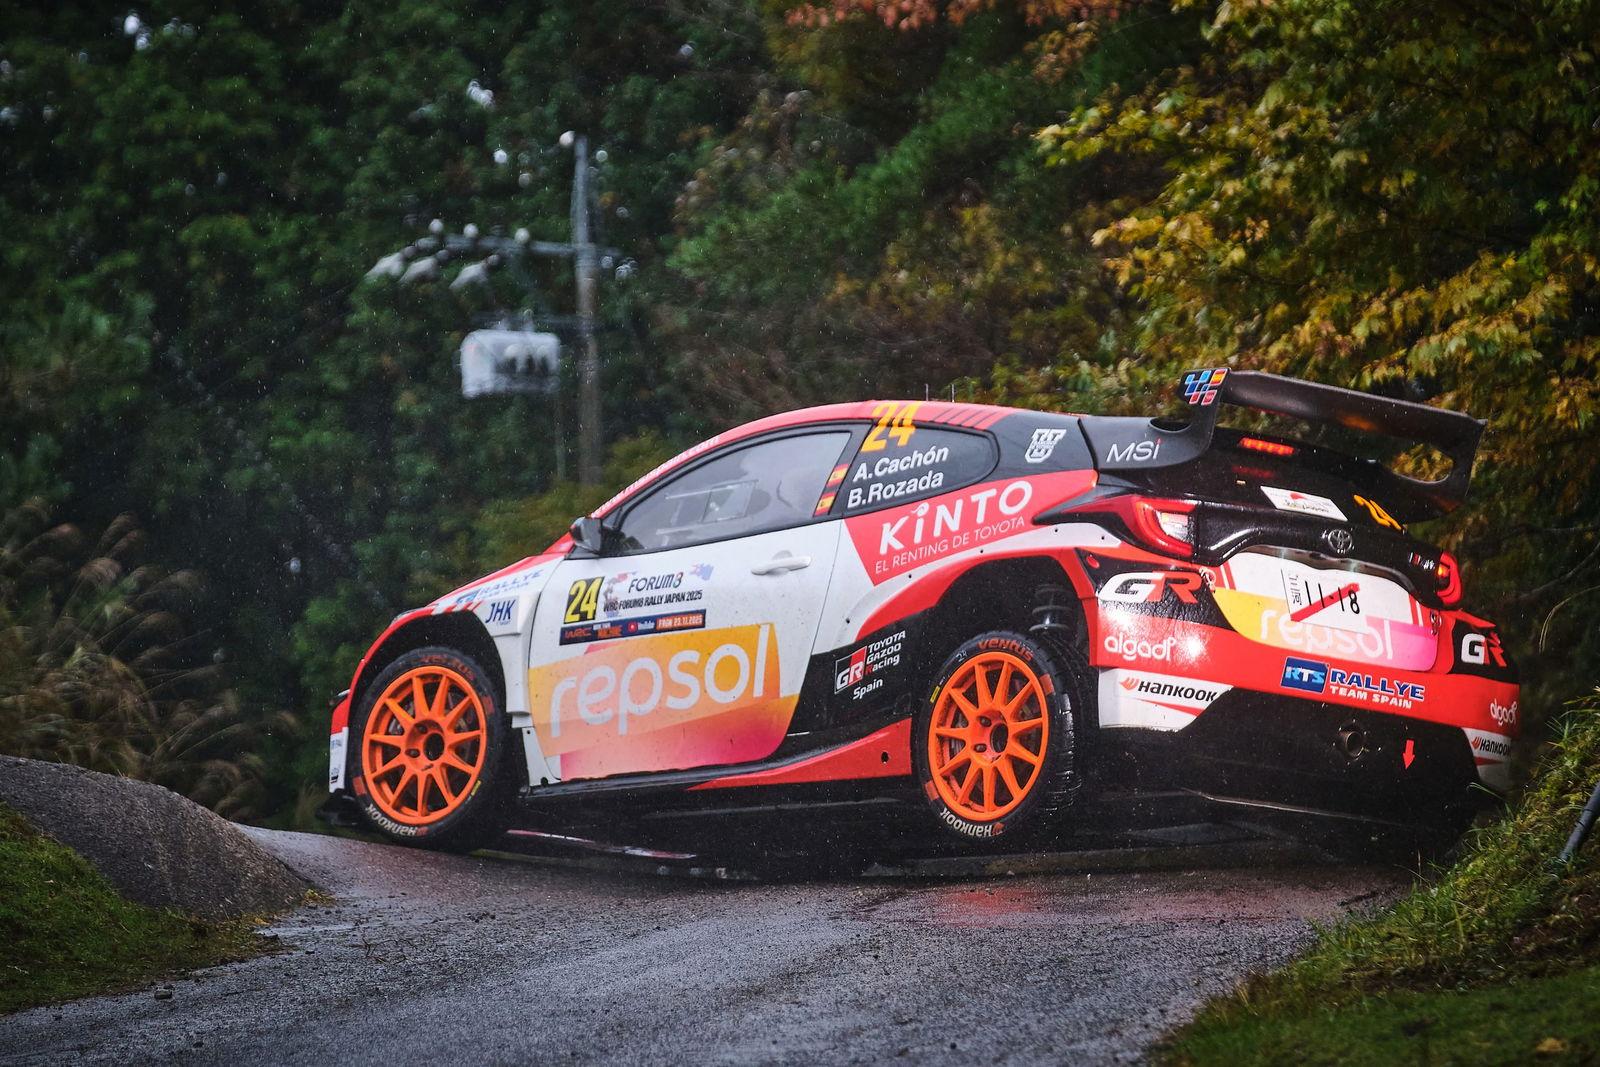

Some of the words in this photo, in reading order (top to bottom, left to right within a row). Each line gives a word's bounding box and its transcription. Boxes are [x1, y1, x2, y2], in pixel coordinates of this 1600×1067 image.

[860, 401, 922, 453] 24
[853, 445, 950, 483] A.Cachón
[847, 470, 944, 509] B.Rozada
[875, 560, 889, 575] EL
[892, 540, 948, 568] RENTING
[953, 532, 970, 549] DE
[974, 516, 1025, 542] TOYOTA
[565, 577, 603, 623] 24
[644, 595, 663, 608] RALLY
[663, 592, 685, 604] JAPAN
[686, 590, 703, 601] 2025
[1096, 570, 1202, 604] GR
[485, 600, 516, 624] JHK
[868, 630, 906, 654] TOYOTA
[1261, 609, 1393, 660] repsol
[1461, 632, 1507, 668] GR
[865, 654, 900, 675] Racing
[866, 643, 902, 665] GAZOO
[551, 623, 771, 738] repsol
[836, 661, 865, 691] GR
[852, 679, 884, 700] Spain
[1284, 666, 1326, 685] RTS
[1330, 668, 1425, 701] RALLYE
[1329, 685, 1368, 701] TEAM
[1372, 693, 1412, 709] SPAIN
